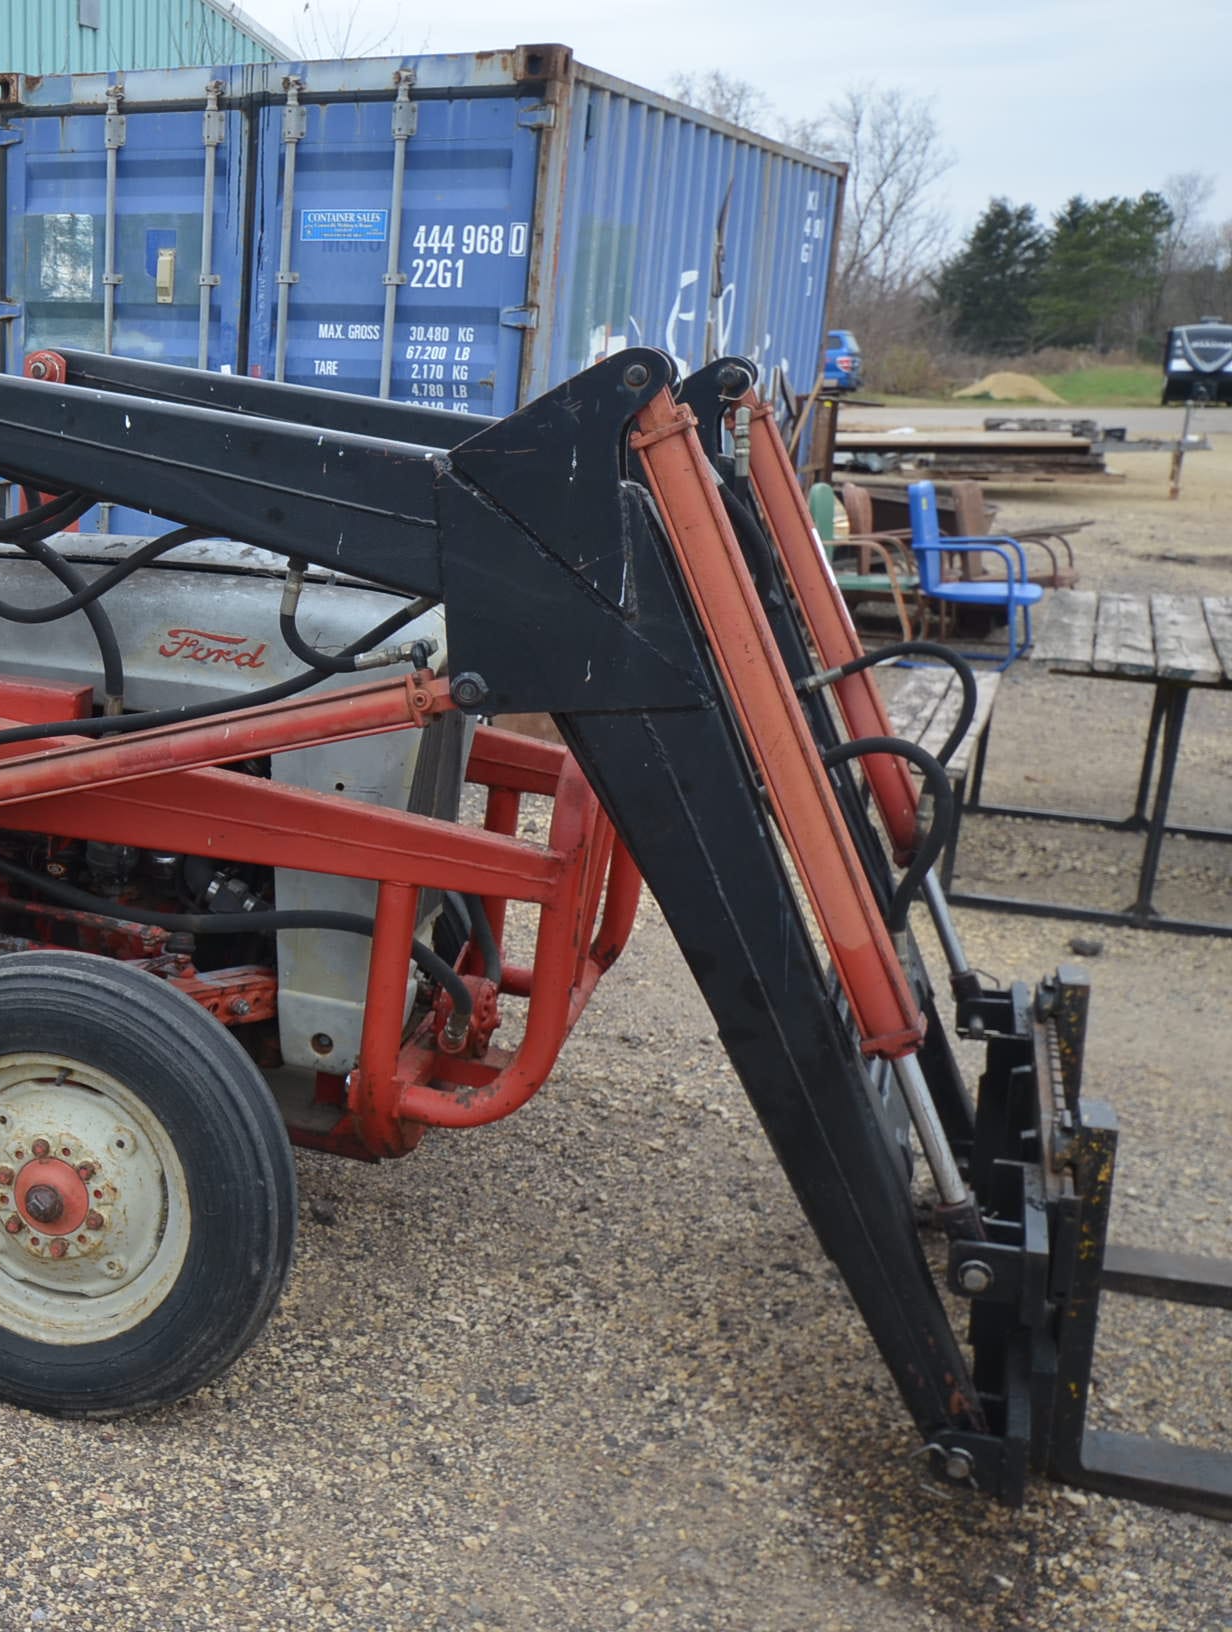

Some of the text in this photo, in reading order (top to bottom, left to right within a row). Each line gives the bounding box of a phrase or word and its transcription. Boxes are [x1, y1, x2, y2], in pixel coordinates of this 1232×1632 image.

[307, 212, 381, 223] CONTAINER SALES
[413, 225, 455, 254] 444
[462, 225, 504, 254] 968
[410, 259, 465, 288] 22G1
[318, 324, 380, 340] MAX. GROSS
[409, 327, 475, 342] 30.480 KG
[406, 346, 471, 361] 67.200 LB
[314, 360, 339, 375] TARE
[411, 364, 469, 380] 2.170 KG
[411, 383, 468, 398] 4.780 LB
[159, 628, 267, 668] Ford
